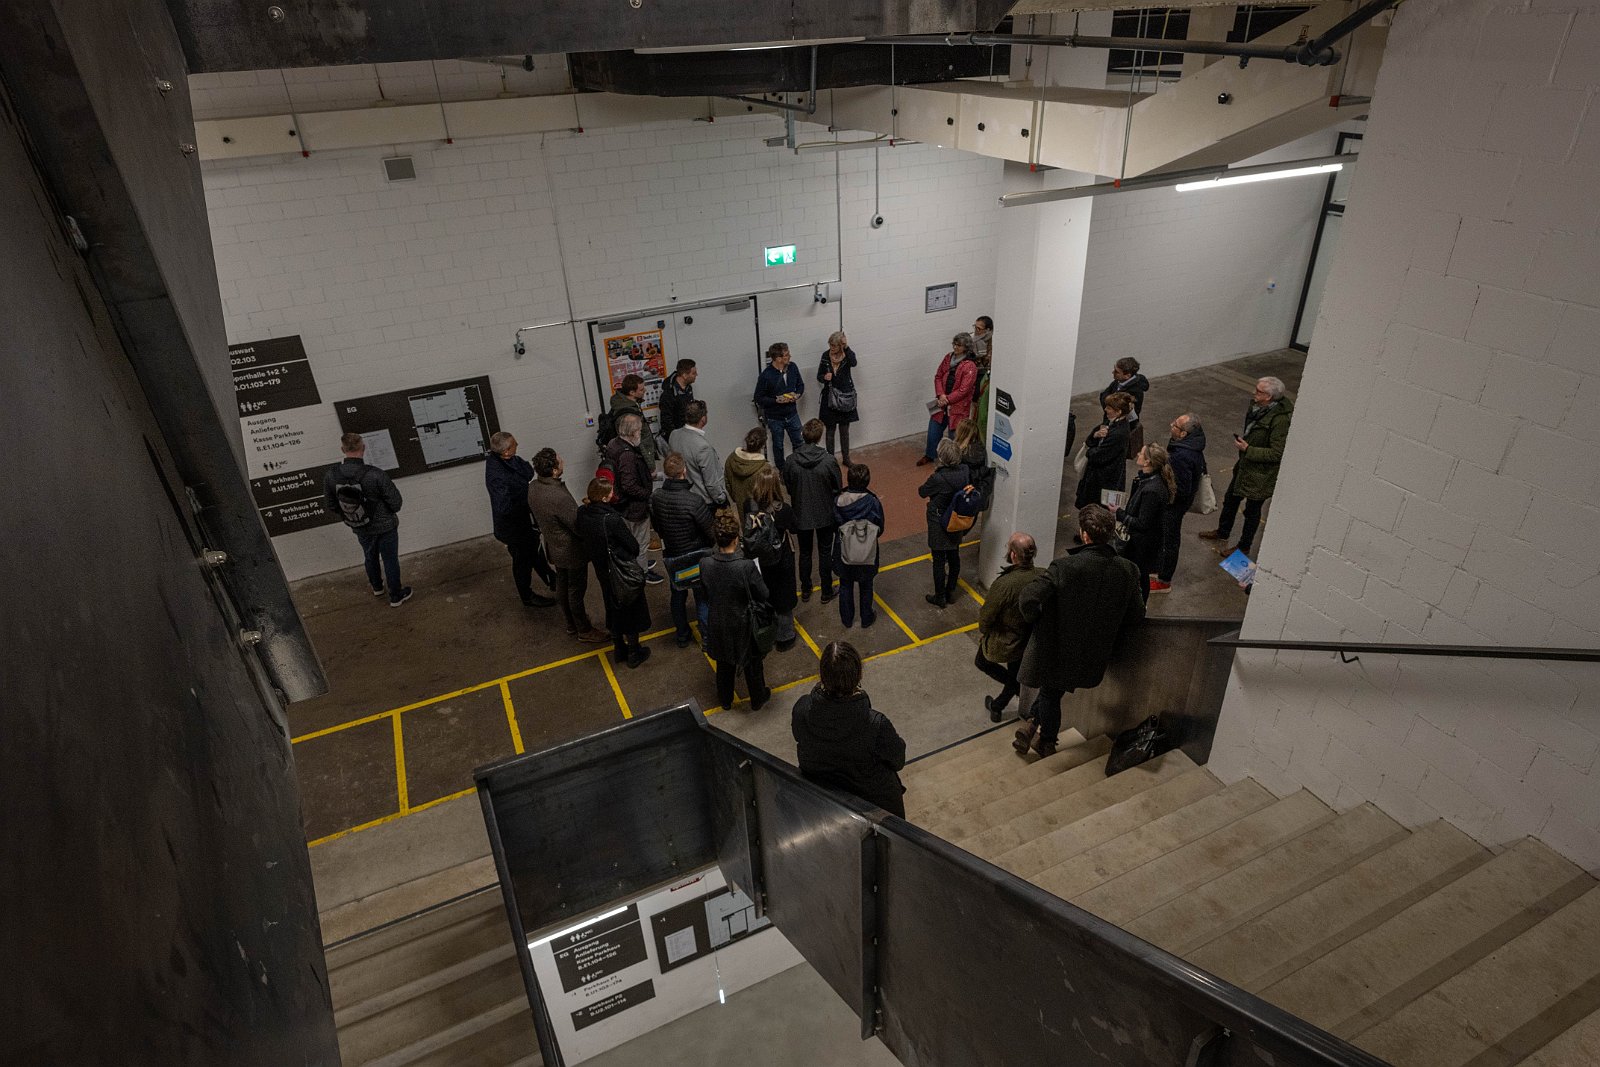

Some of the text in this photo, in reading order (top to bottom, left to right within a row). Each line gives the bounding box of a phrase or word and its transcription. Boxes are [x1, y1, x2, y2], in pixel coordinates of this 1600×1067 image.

[233, 368, 280, 383] porthalle 1+2
[346, 406, 358, 414] EG
[247, 417, 277, 427] Ausgang
[250, 424, 290, 435] Anlieferung
[253, 430, 304, 444] Kasse Parkhaus
[268, 474, 299, 485] Parkhaus
[298, 472, 308, 480] P1
[280, 504, 309, 515] Parkhaus
[559, 940, 600, 959] EG Ausgang
[575, 942, 609, 959] Anlieferung
[576, 944, 621, 965] Kasse Parkhaus
[588, 998, 615, 1011] Parkhaus
